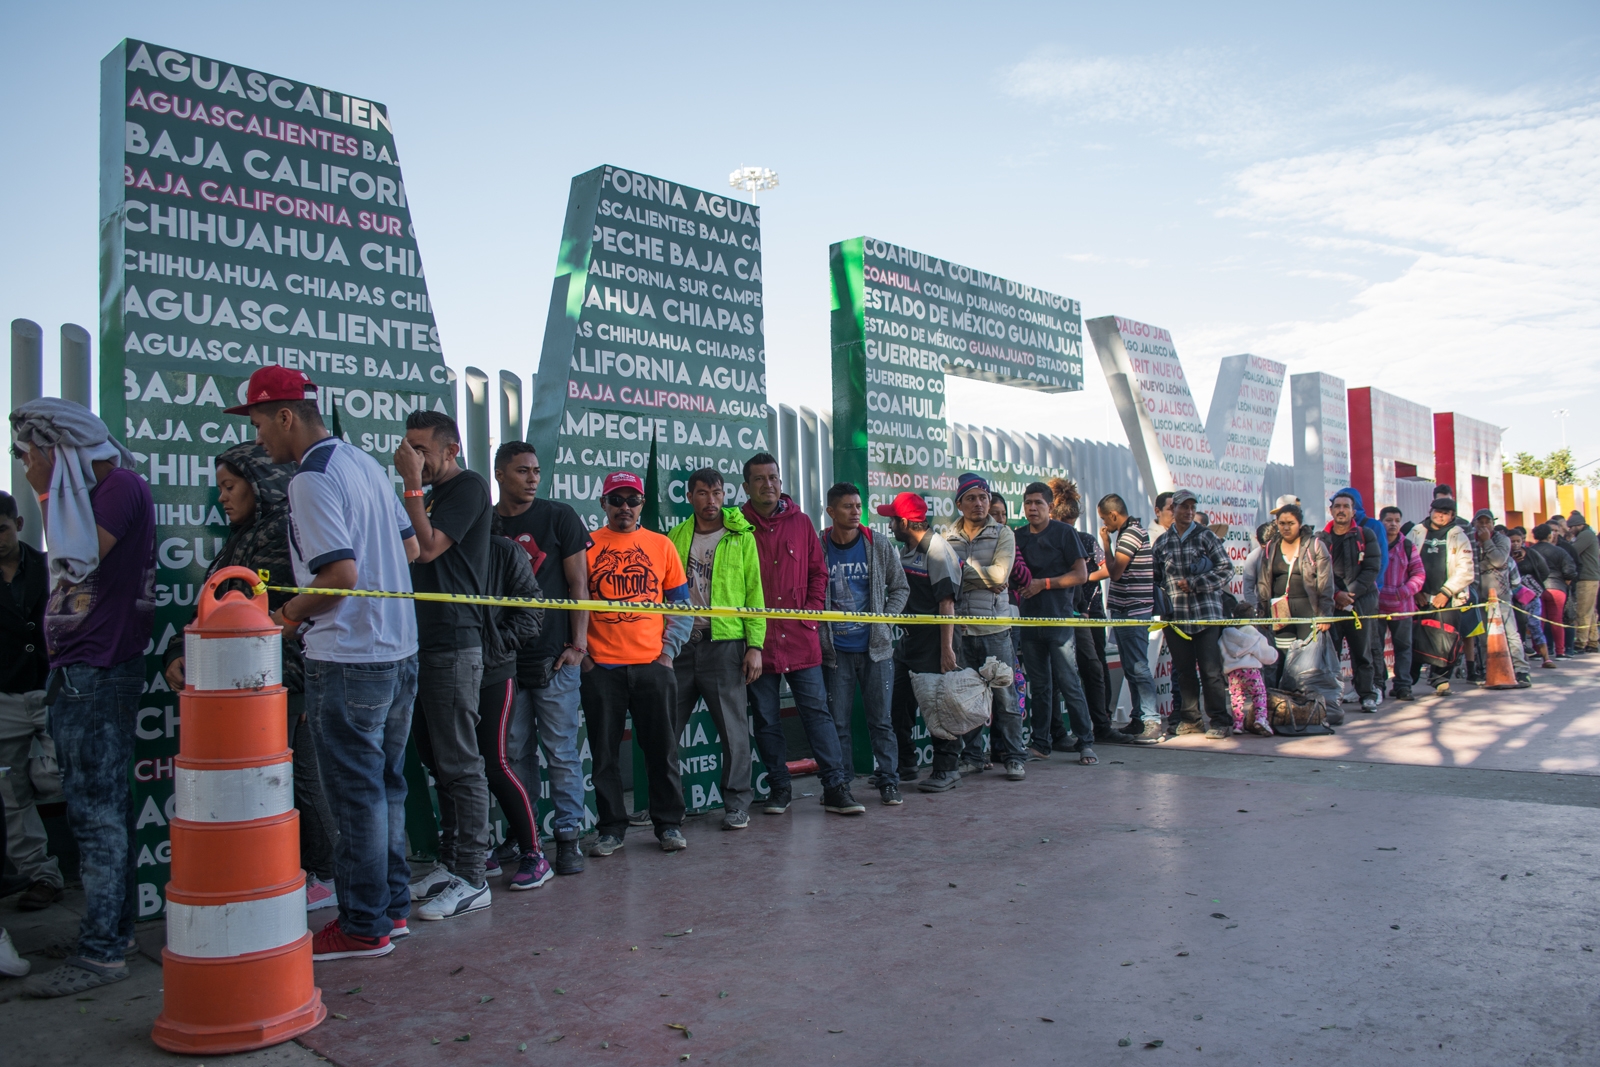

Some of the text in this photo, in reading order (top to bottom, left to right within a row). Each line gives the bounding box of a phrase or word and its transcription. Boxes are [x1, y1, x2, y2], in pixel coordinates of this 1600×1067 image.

[127, 43, 392, 135] AGUASCALIEN
[129, 87, 400, 167] AGUASCALIENTES BA
[125, 122, 232, 174] BAJA
[124, 166, 193, 198] BAJA
[200, 181, 352, 228] CALIFORNIA
[358, 210, 404, 238] SUR
[124, 200, 424, 279] CHIHUAHUA CHI
[700, 223, 738, 247] BAJA
[670, 242, 728, 276] BAJA
[863, 238, 945, 277] COAHUILA
[948, 262, 1002, 294] COLIMA
[1006, 279, 1070, 313] DURANGO
[124, 248, 279, 291] CHIHUAHUA
[285, 274, 386, 306] CHIAPAS
[588, 259, 764, 308] ALIFORNIA SUR CAMPE
[585, 284, 656, 319] AHUA
[662, 299, 754, 336] CHIAPAS
[864, 265, 922, 294] COAHUILA
[923, 282, 964, 307] COLIMA
[966, 294, 1016, 318] DURANGO
[1018, 308, 1062, 332] COAHUILA
[864, 286, 926, 321] ESTADO
[930, 304, 949, 326] DE
[952, 307, 1006, 340] MÉXICO
[125, 284, 442, 354] AGUASCALIENTES
[125, 330, 358, 375] AGUASCALIENTES
[364, 356, 424, 382] BAJA
[596, 324, 692, 353] CHIHUAHUA
[696, 339, 755, 362] CHIAPAS
[865, 316, 1082, 377] ESTADO DE MÉXICO GUANAJUATO ESTADO DE
[866, 339, 950, 374] GUERRERO
[1140, 343, 1168, 357] JALISCO
[125, 368, 226, 408] BAJA
[699, 365, 766, 395] AGUAS
[866, 367, 946, 394] GUERRERO CO
[1140, 380, 1164, 392] NUEVO
[1166, 382, 1181, 395] LEÓN
[1152, 361, 1183, 380] NUEVO
[568, 380, 768, 419] BAJA CALIFORNIA AGUAS
[867, 390, 946, 420] COAHUILA
[1159, 399, 1194, 417] JALISCO
[1250, 387, 1275, 403] NUEVO
[126, 416, 193, 442] BAJA
[560, 410, 768, 451] MPECHE BAJA CA
[867, 419, 924, 440] COAHUILA
[1162, 433, 1193, 451] NUEVO
[868, 441, 930, 467] ESTADO
[934, 448, 952, 469] DE
[1175, 454, 1192, 467] LEÓN
[868, 471, 911, 488] ESTADO
[914, 474, 929, 489] DE
[1205, 475, 1253, 493] MICHOACÁN
[1222, 512, 1254, 526] NAYARIT
